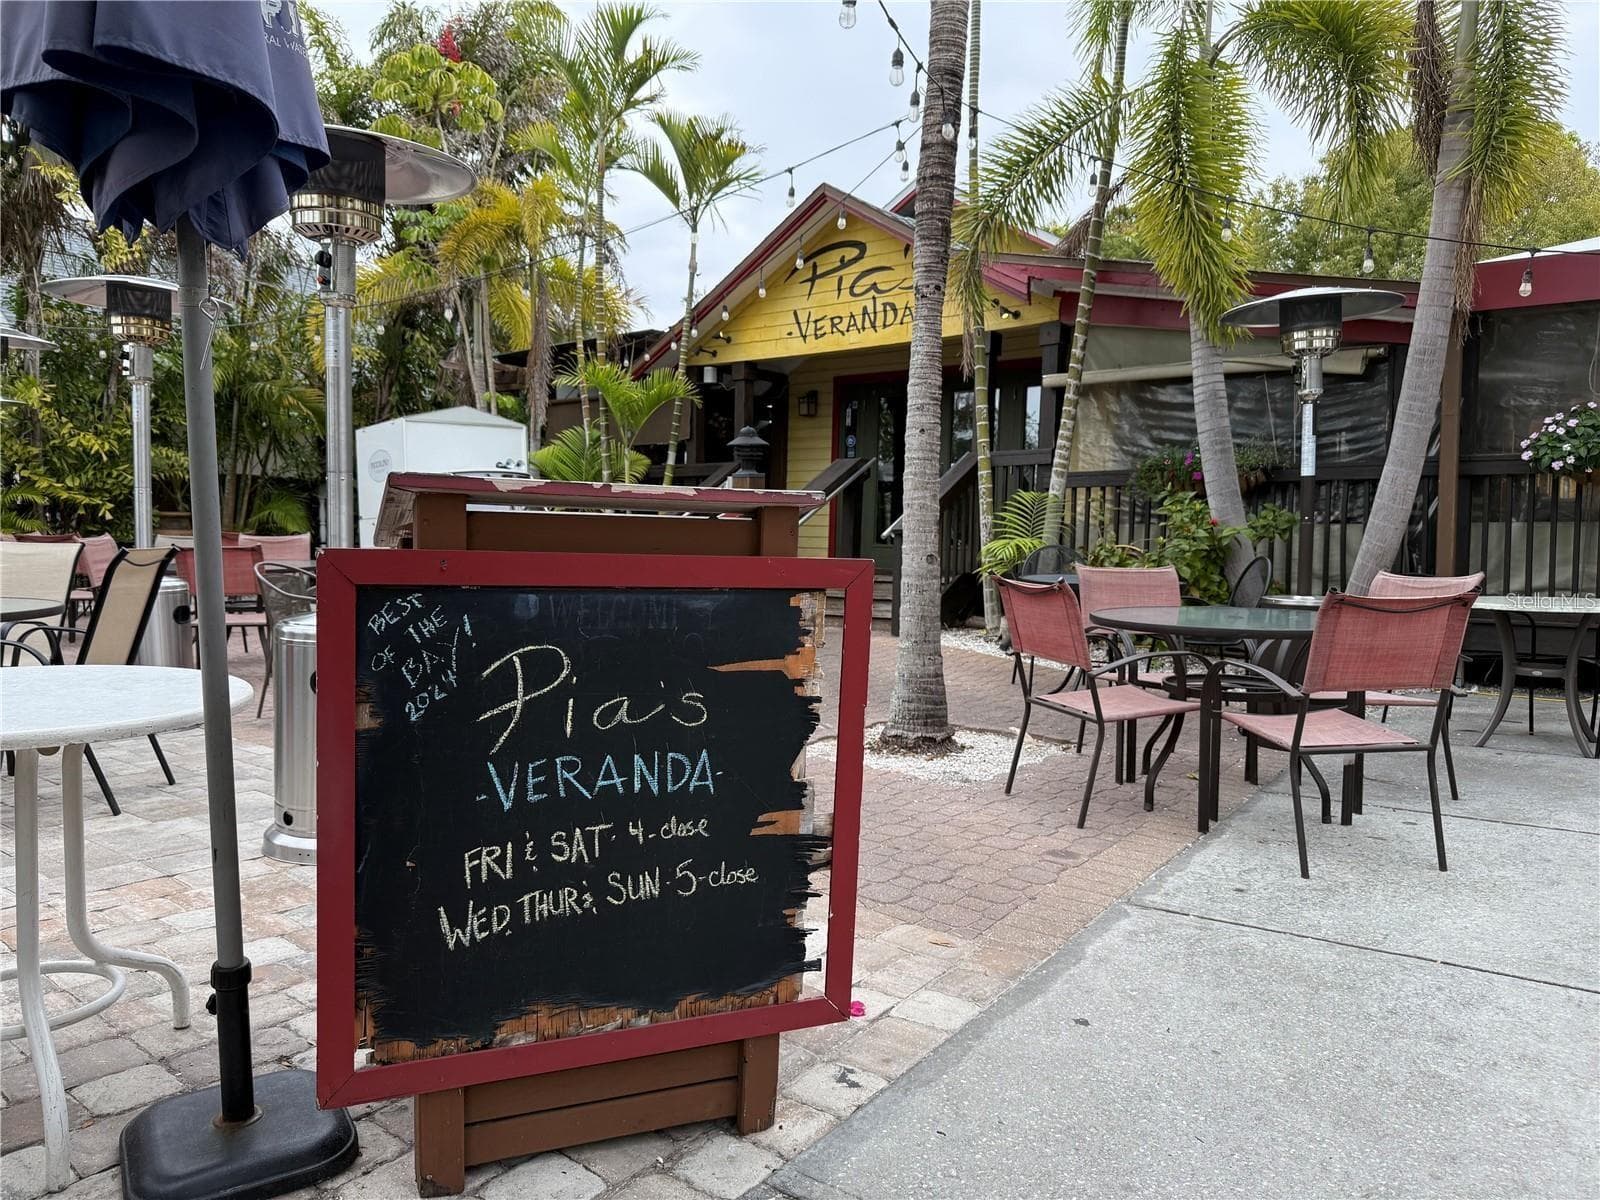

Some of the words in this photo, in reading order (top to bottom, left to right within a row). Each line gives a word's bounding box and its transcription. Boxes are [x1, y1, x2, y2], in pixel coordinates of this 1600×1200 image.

[367, 592, 424, 636] BEST
[371, 644, 396, 672] OF
[403, 604, 448, 644] THE
[476, 645, 709, 755] Pia's
[463, 841, 513, 889] FRI
